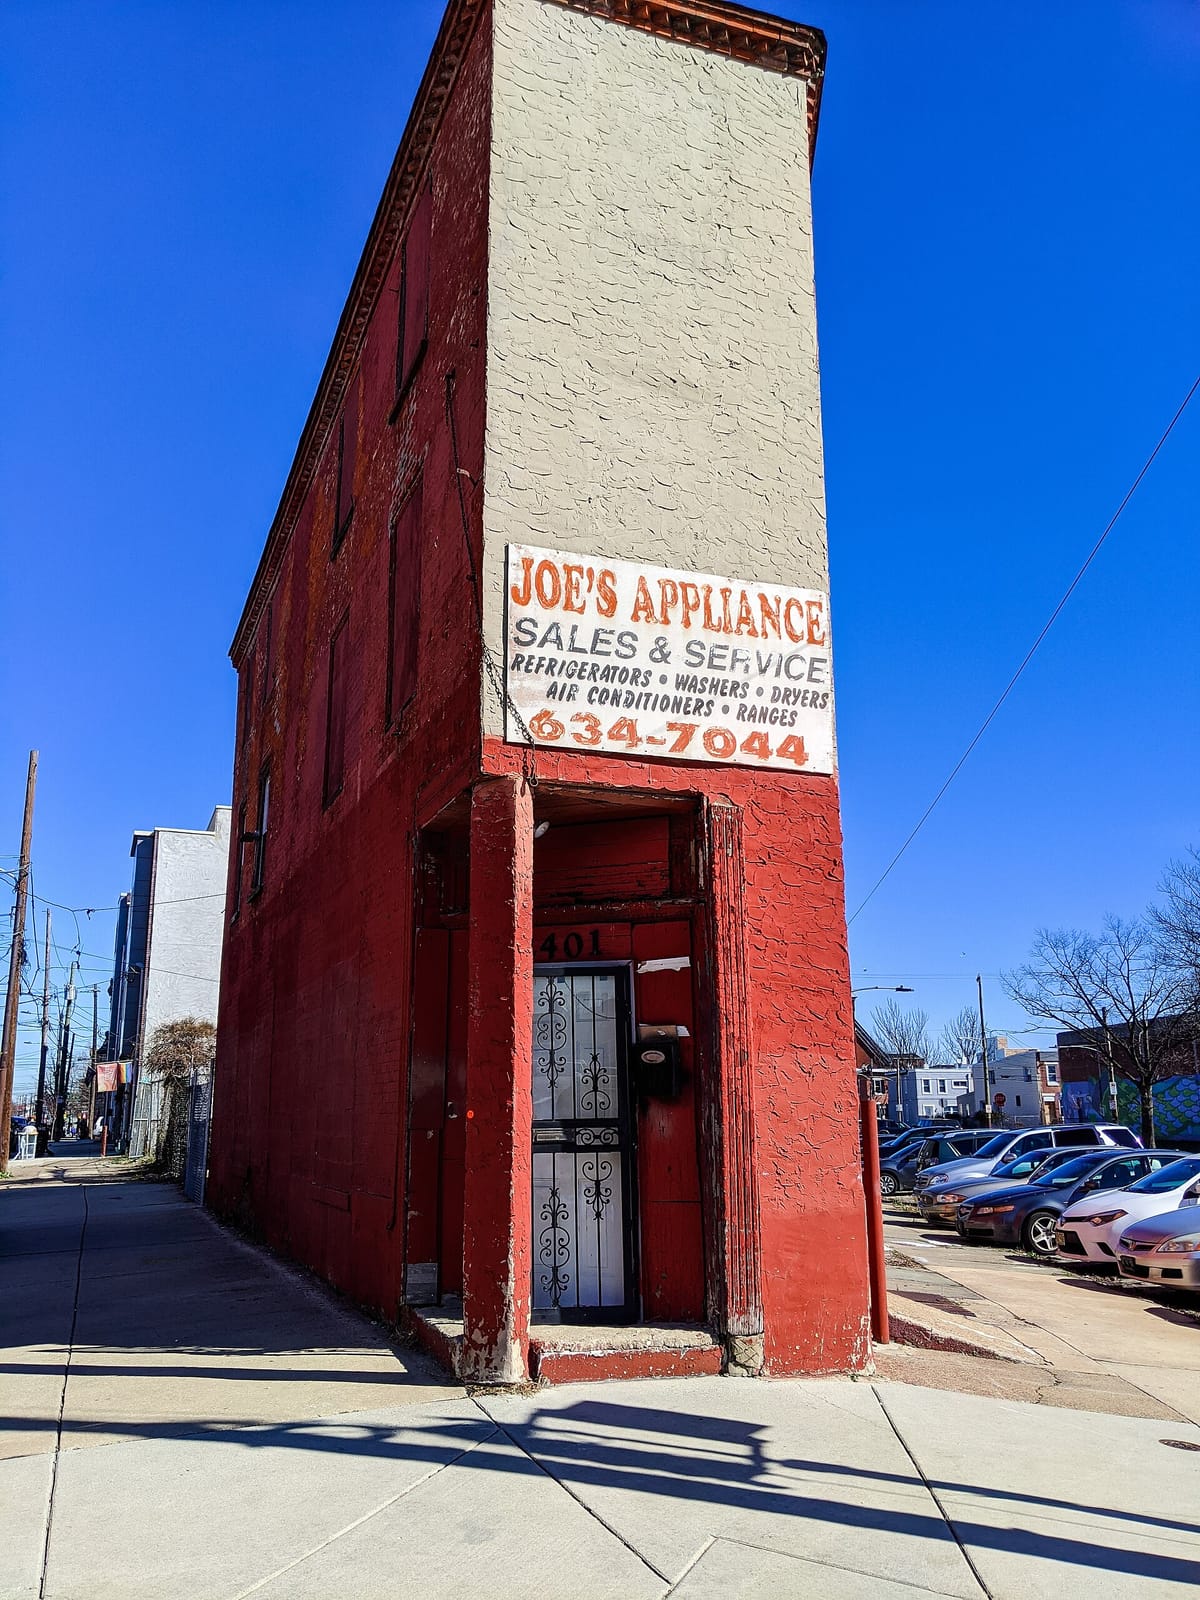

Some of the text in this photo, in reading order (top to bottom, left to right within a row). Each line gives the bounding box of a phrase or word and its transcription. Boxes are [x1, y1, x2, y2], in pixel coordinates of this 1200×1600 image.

[511, 557, 827, 646] JOE'S APPLIANCE
[512, 617, 828, 684] SALES & SERVICE
[511, 653, 829, 710] REFRIGERATORS WASHERS DRYERS
[546, 681, 798, 727] AIR CONDITIONERS RANGES
[528, 707, 810, 766] 634-7044
[540, 929, 602, 959] 401
